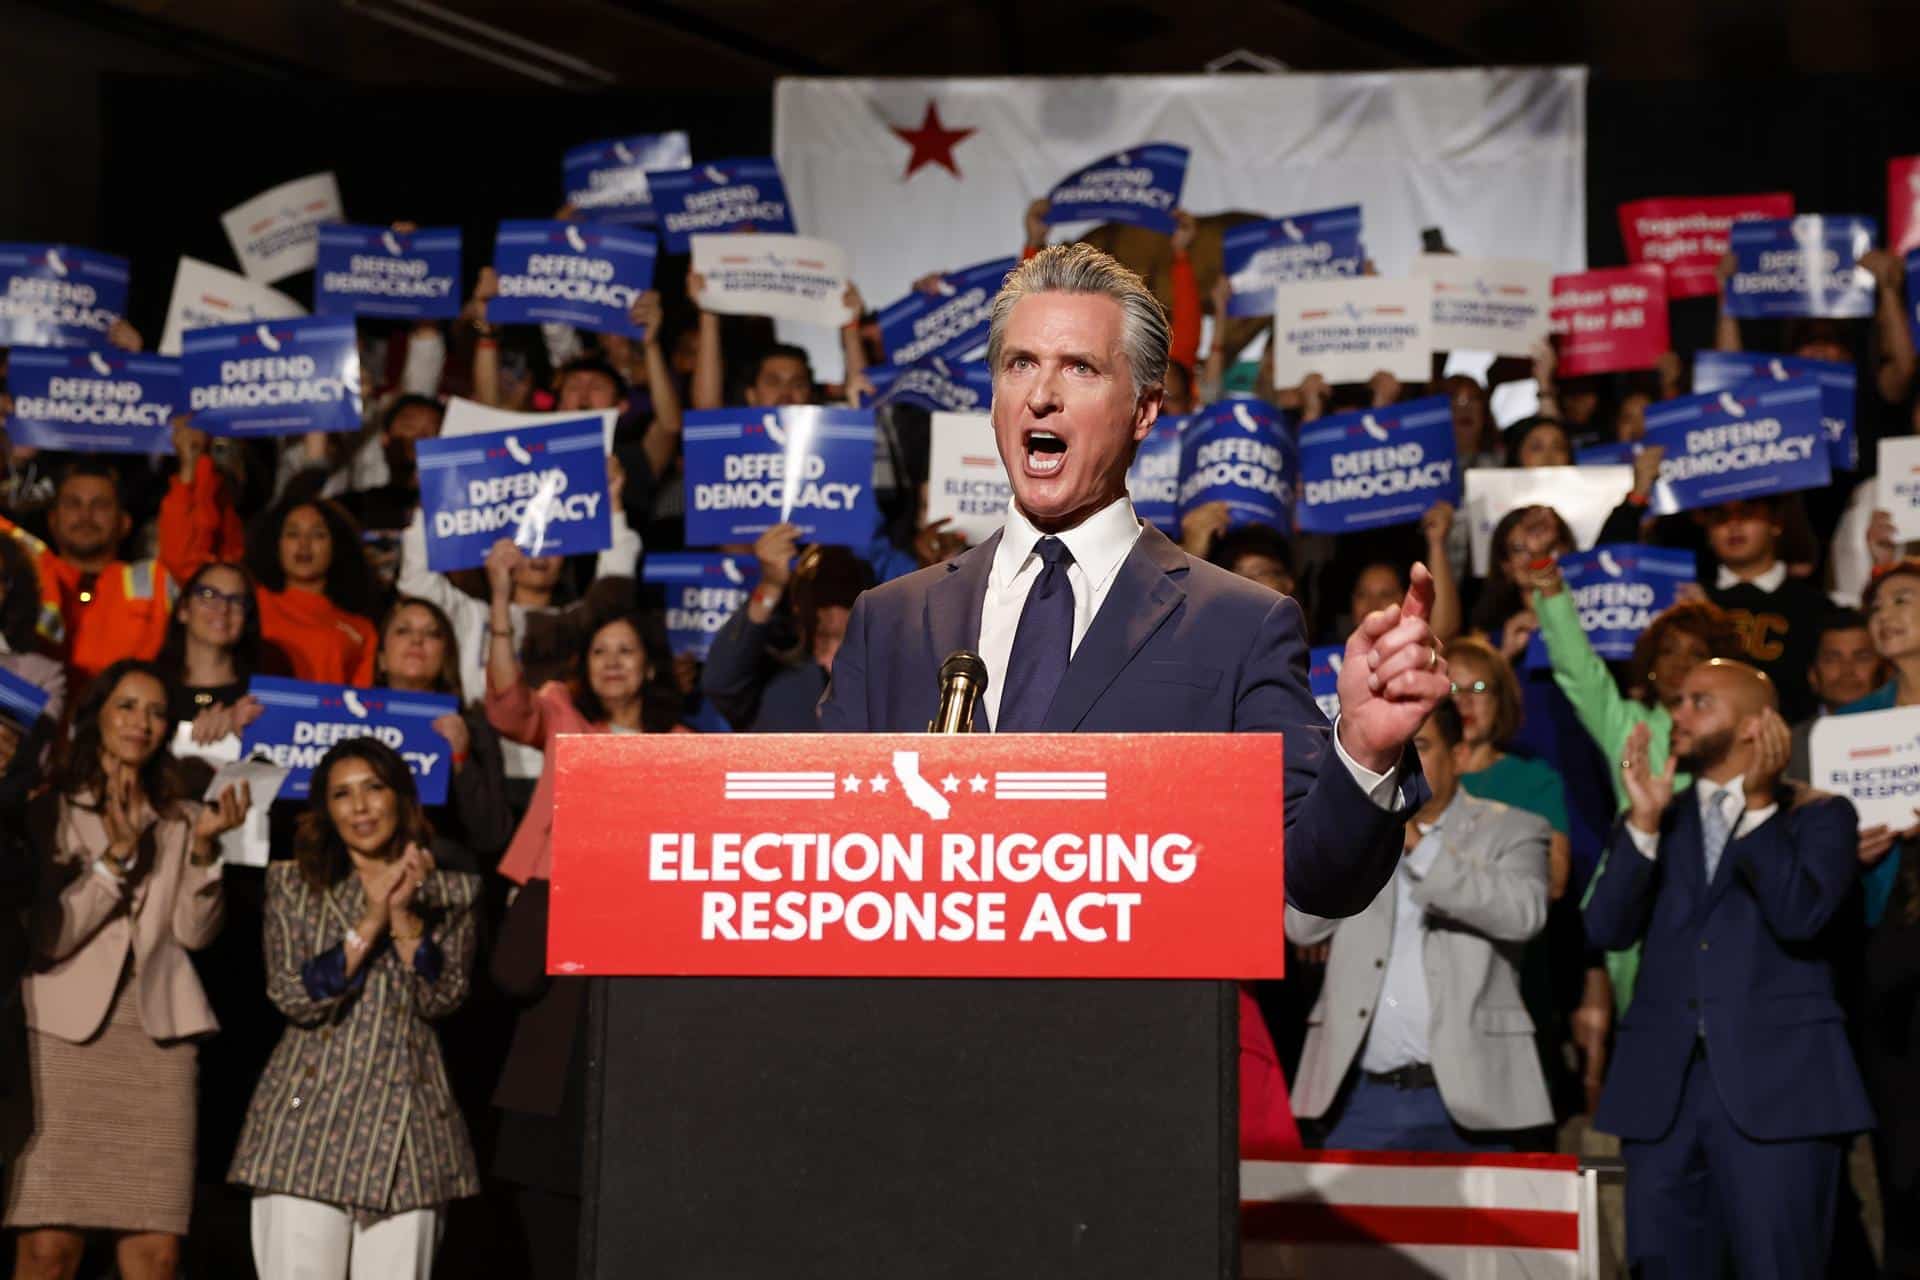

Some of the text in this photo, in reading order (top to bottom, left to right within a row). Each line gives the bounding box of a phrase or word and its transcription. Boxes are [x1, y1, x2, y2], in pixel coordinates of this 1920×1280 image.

[684, 184, 760, 211] DEFEND
[665, 202, 785, 233] DEMOCRACY
[351, 254, 429, 279] DEFEND
[527, 253, 615, 284] DEFEND
[1759, 249, 1839, 272] DEFED
[8, 276, 96, 307] DEFEND
[323, 272, 454, 299] DEMOCRACY
[221, 354, 315, 384] DEFEND
[50, 377, 143, 403] DEFEND
[190, 376, 346, 411] DEMOCRACY
[15, 395, 173, 427] DEMOCRACY
[1686, 418, 1781, 455] DEFEND
[723, 454, 825, 481] DEFED
[1197, 436, 1283, 470] DEFEND
[1331, 442, 1424, 479] DEFEND
[1658, 433, 1817, 483] DEMOCRACY
[469, 467, 568, 506] DEFEND
[944, 477, 1010, 497] ELECTIO
[1304, 459, 1452, 506] DEMOCRACY
[434, 492, 601, 539] DEMOCACY
[683, 587, 748, 611] DEFE
[1852, 783, 1920, 799] RESPO
[649, 833, 1197, 881] ELECTION RIGGING
[701, 892, 1141, 941] RESPONSE ACT
